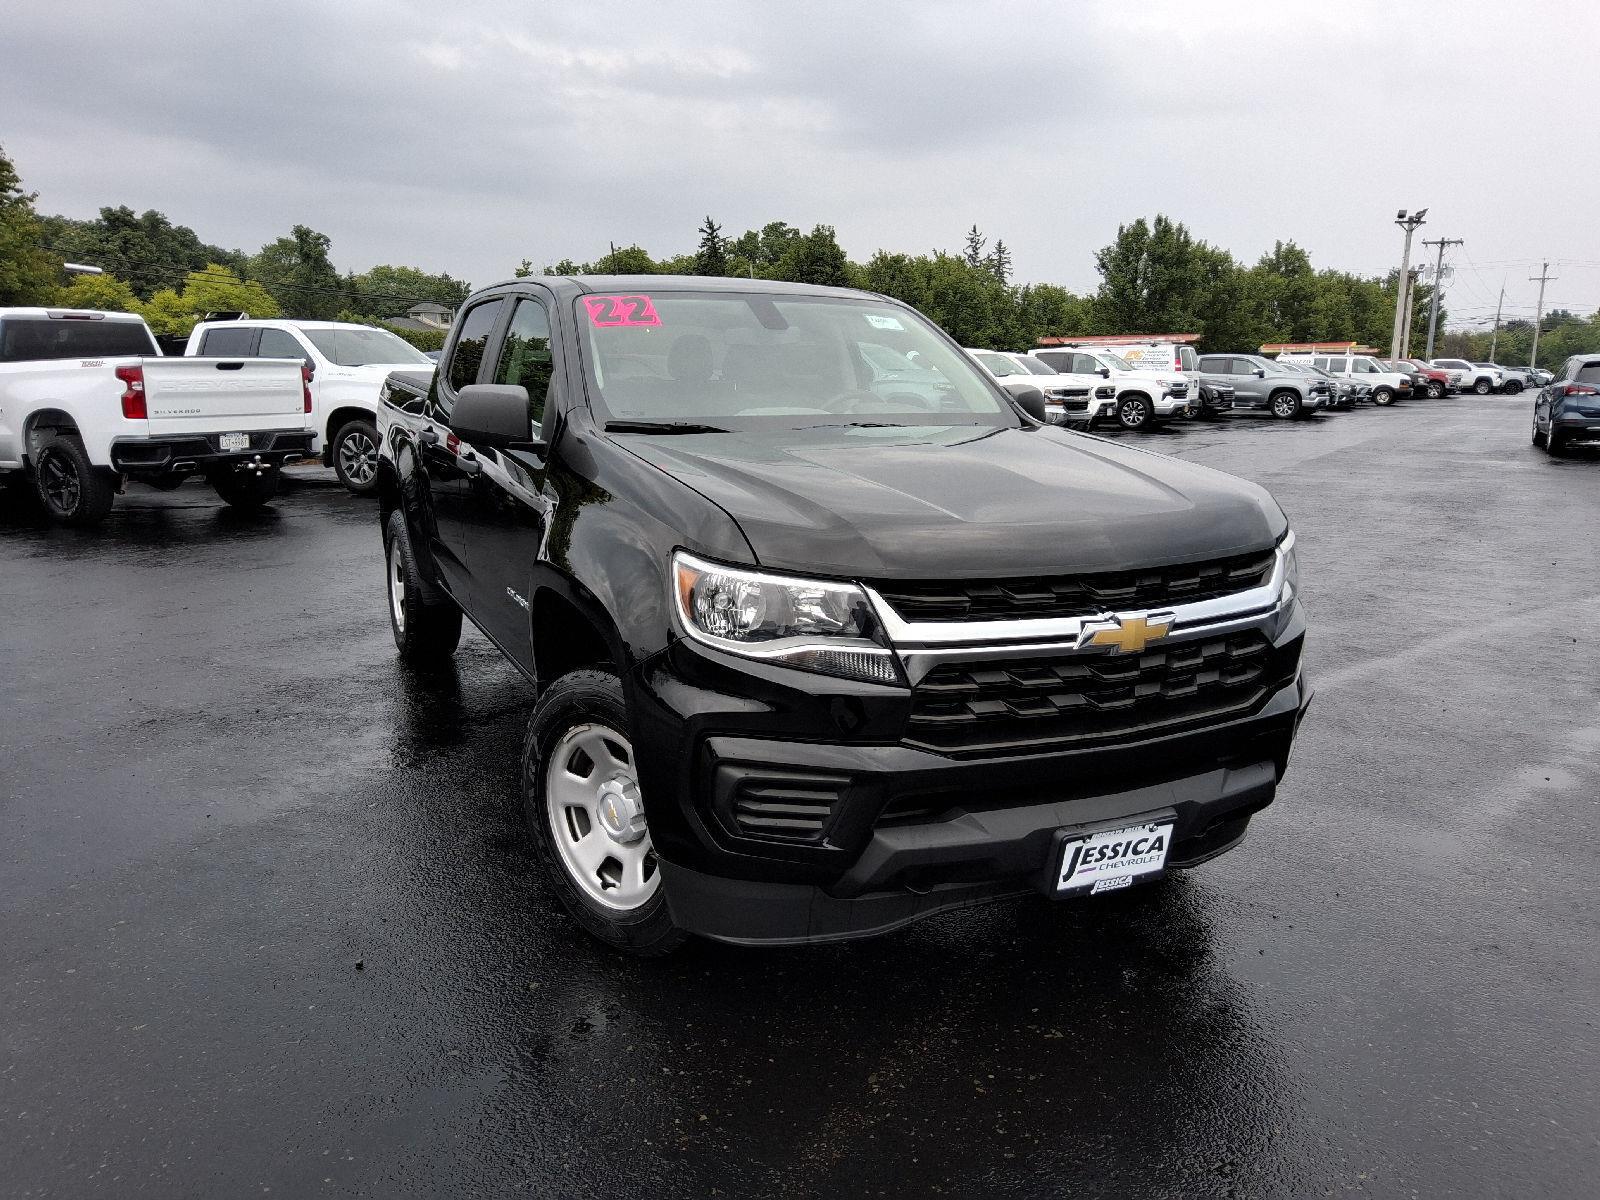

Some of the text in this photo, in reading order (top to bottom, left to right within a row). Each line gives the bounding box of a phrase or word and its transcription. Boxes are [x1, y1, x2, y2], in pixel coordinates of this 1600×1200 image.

[589, 297, 656, 322] 22
[1062, 835, 1164, 883] JESSICA
[1099, 855, 1162, 870] CHEVROLET
[1090, 876, 1132, 894] JESSICA
